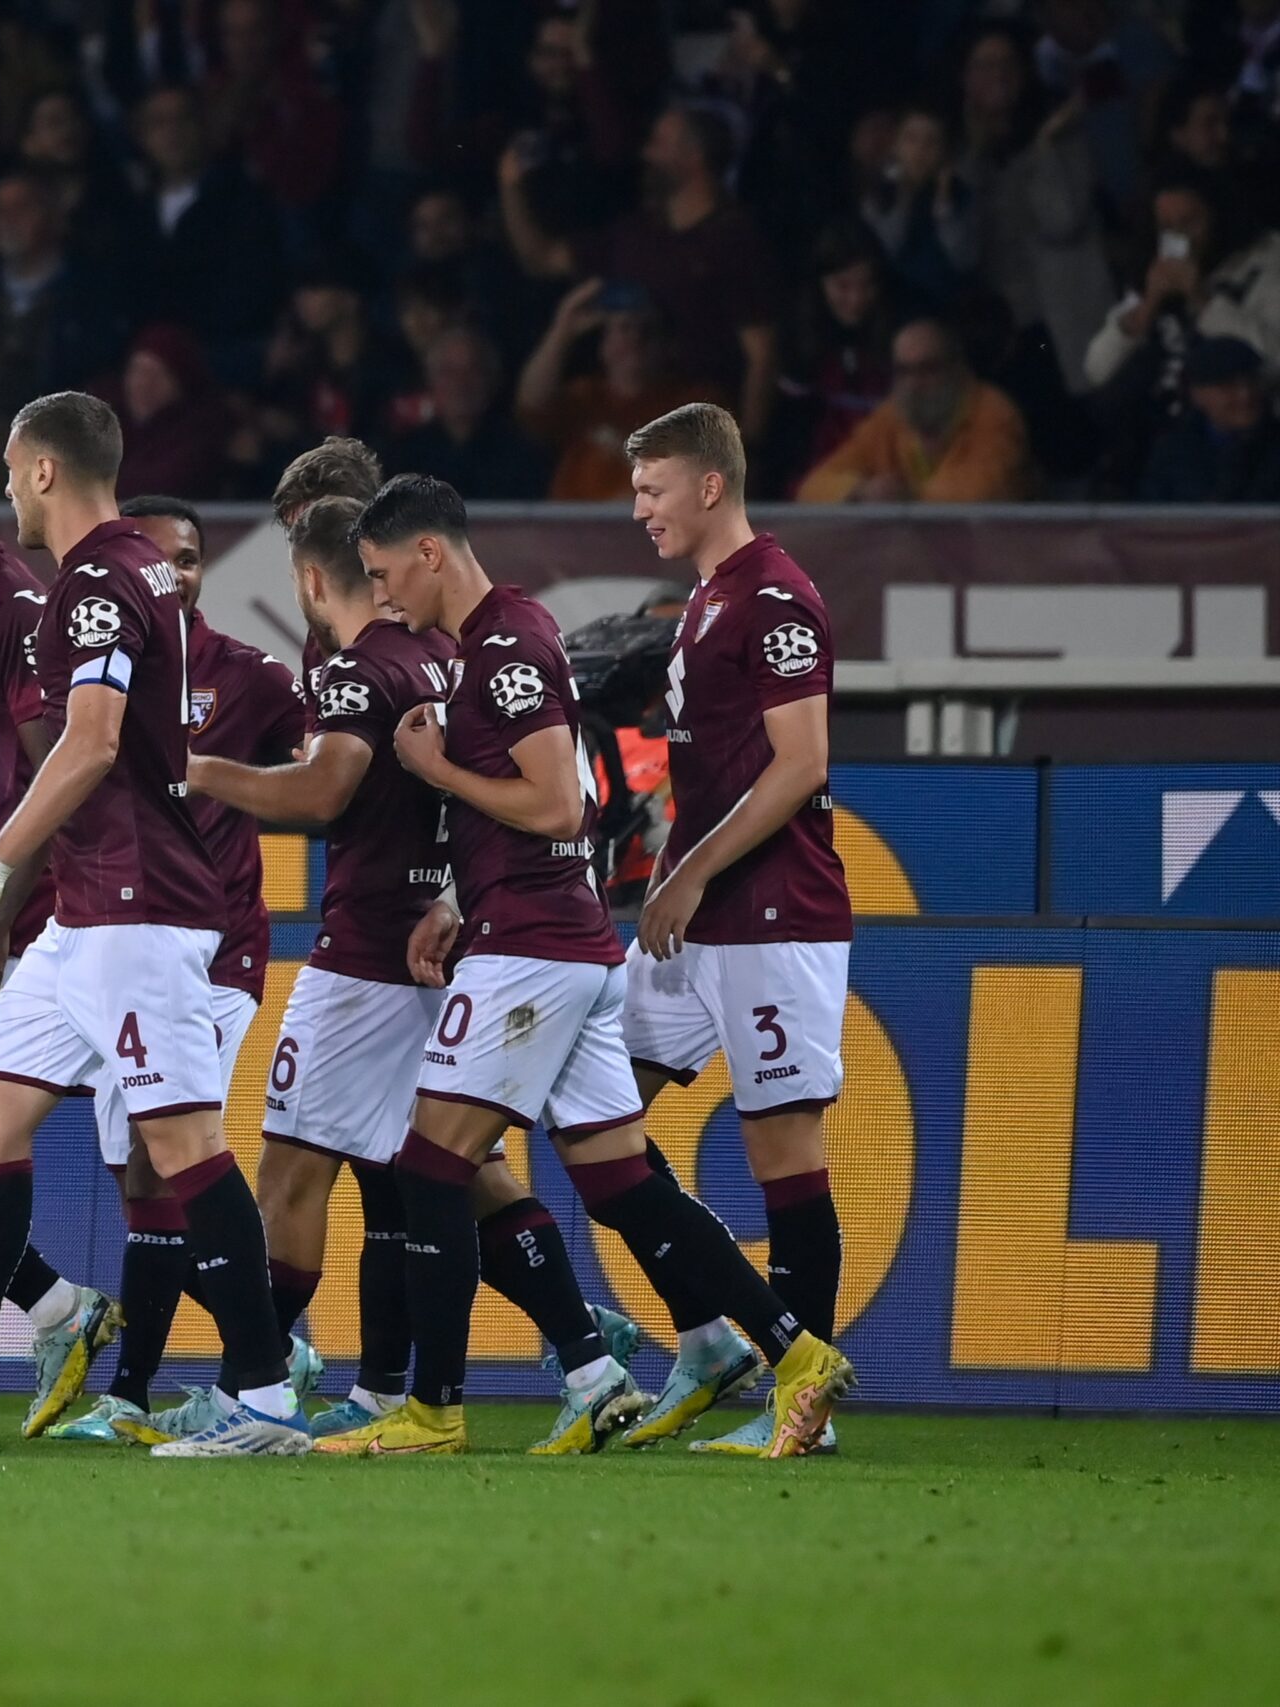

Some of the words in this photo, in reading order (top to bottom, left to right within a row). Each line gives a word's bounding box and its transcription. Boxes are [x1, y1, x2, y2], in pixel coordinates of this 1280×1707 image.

[68, 601, 121, 637] 38
[763, 627, 818, 664] 38
[778, 656, 814, 674] Wüber
[320, 684, 370, 718] 38
[489, 665, 544, 707] 38
[504, 695, 540, 716] Wüber
[116, 1011, 148, 1069] 4
[752, 1004, 787, 1061] 3
